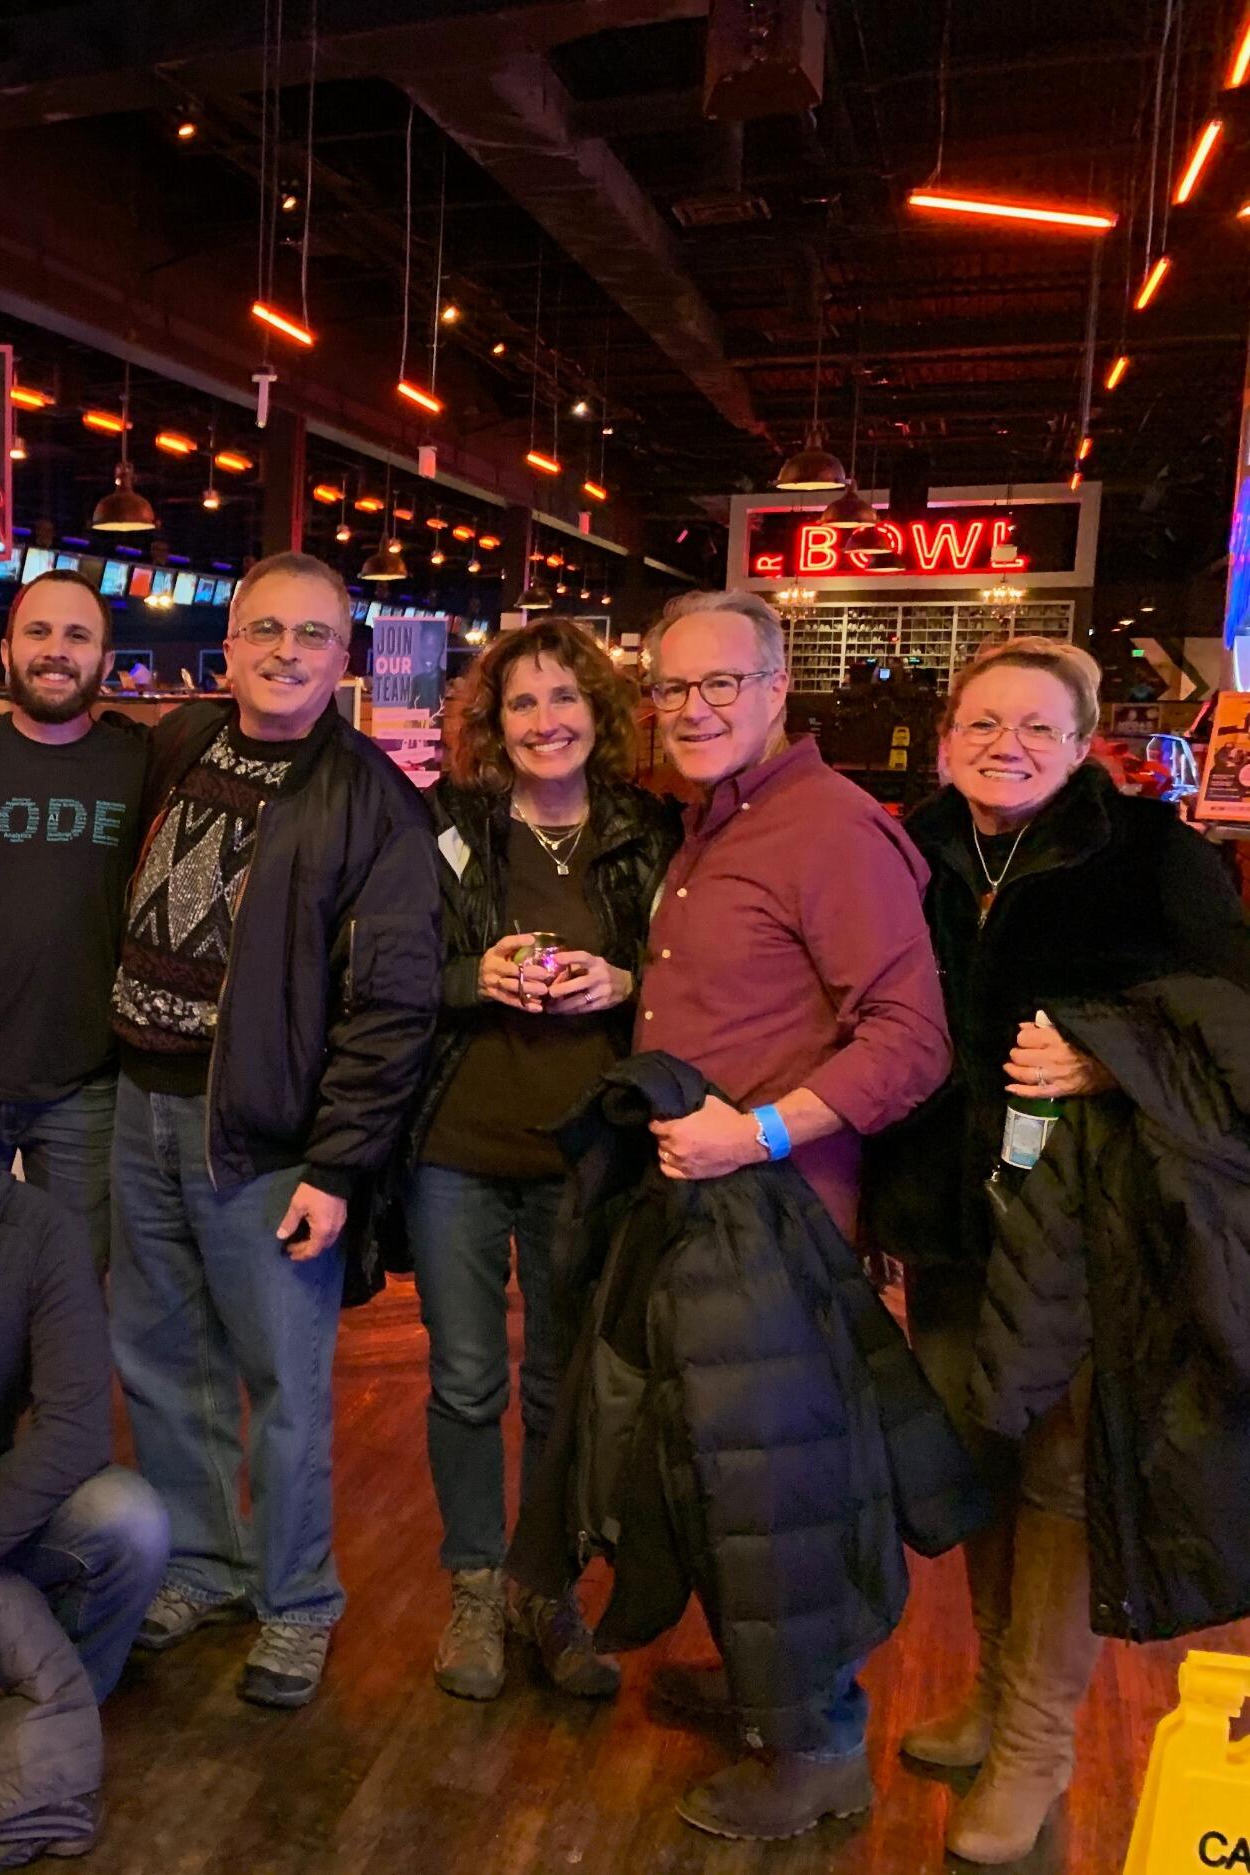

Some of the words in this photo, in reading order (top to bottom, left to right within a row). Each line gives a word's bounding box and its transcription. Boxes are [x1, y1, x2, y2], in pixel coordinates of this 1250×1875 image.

[376, 625, 413, 656] JOIN
[375, 656, 412, 675] OUR
[375, 675, 413, 703] TEAM
